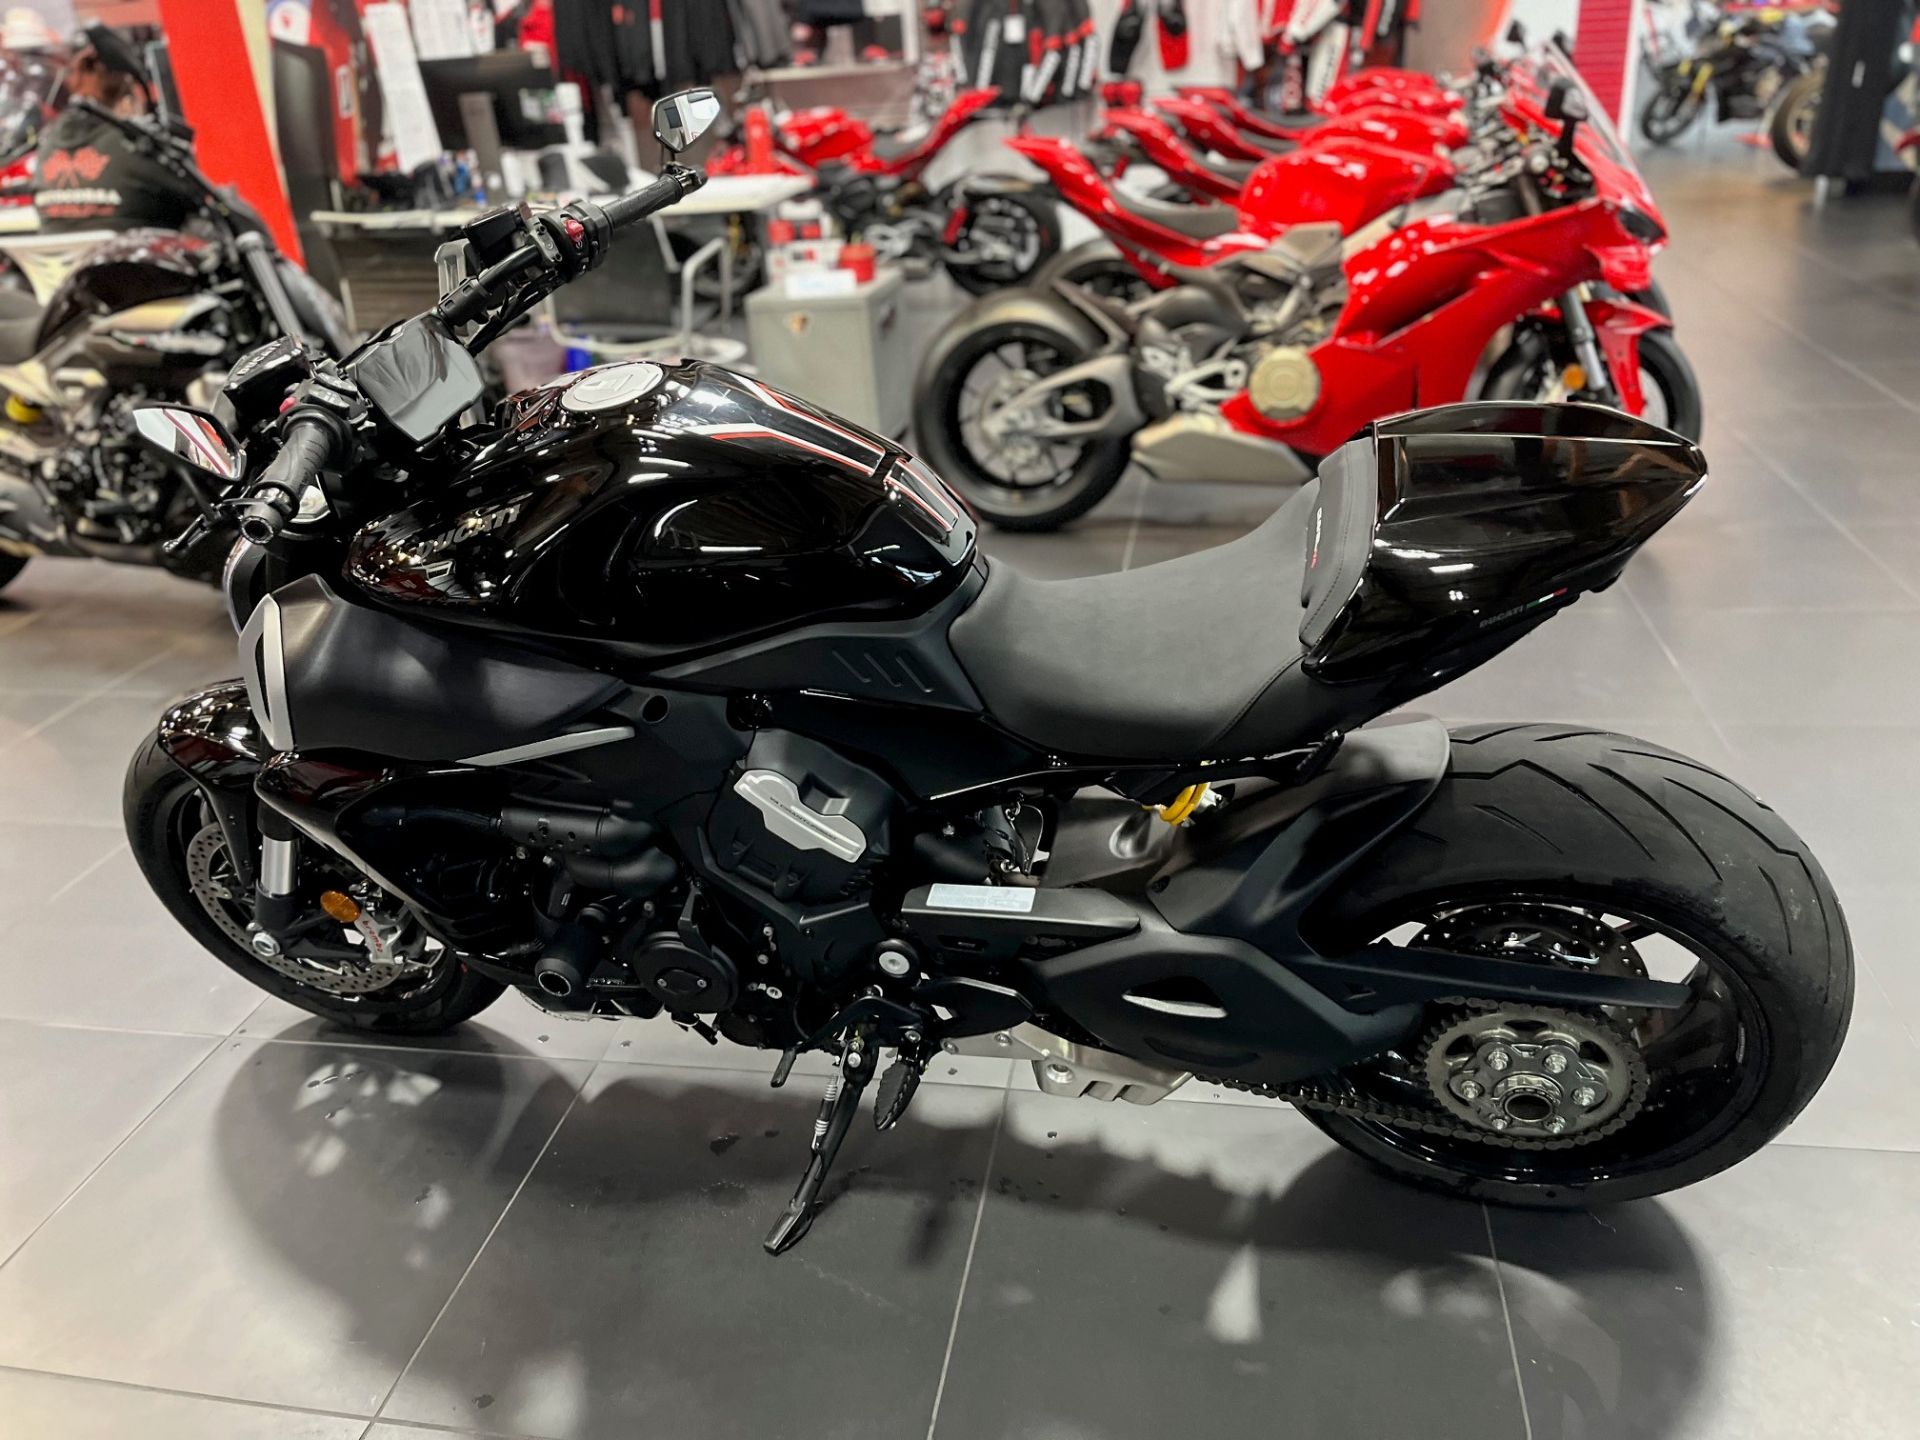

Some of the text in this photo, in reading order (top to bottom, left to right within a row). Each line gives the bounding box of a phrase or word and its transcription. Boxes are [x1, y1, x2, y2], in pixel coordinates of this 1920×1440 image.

[415, 504, 521, 561] DUCATI
[1479, 604, 1525, 629] DUCATI
[362, 920, 383, 953] brembo
